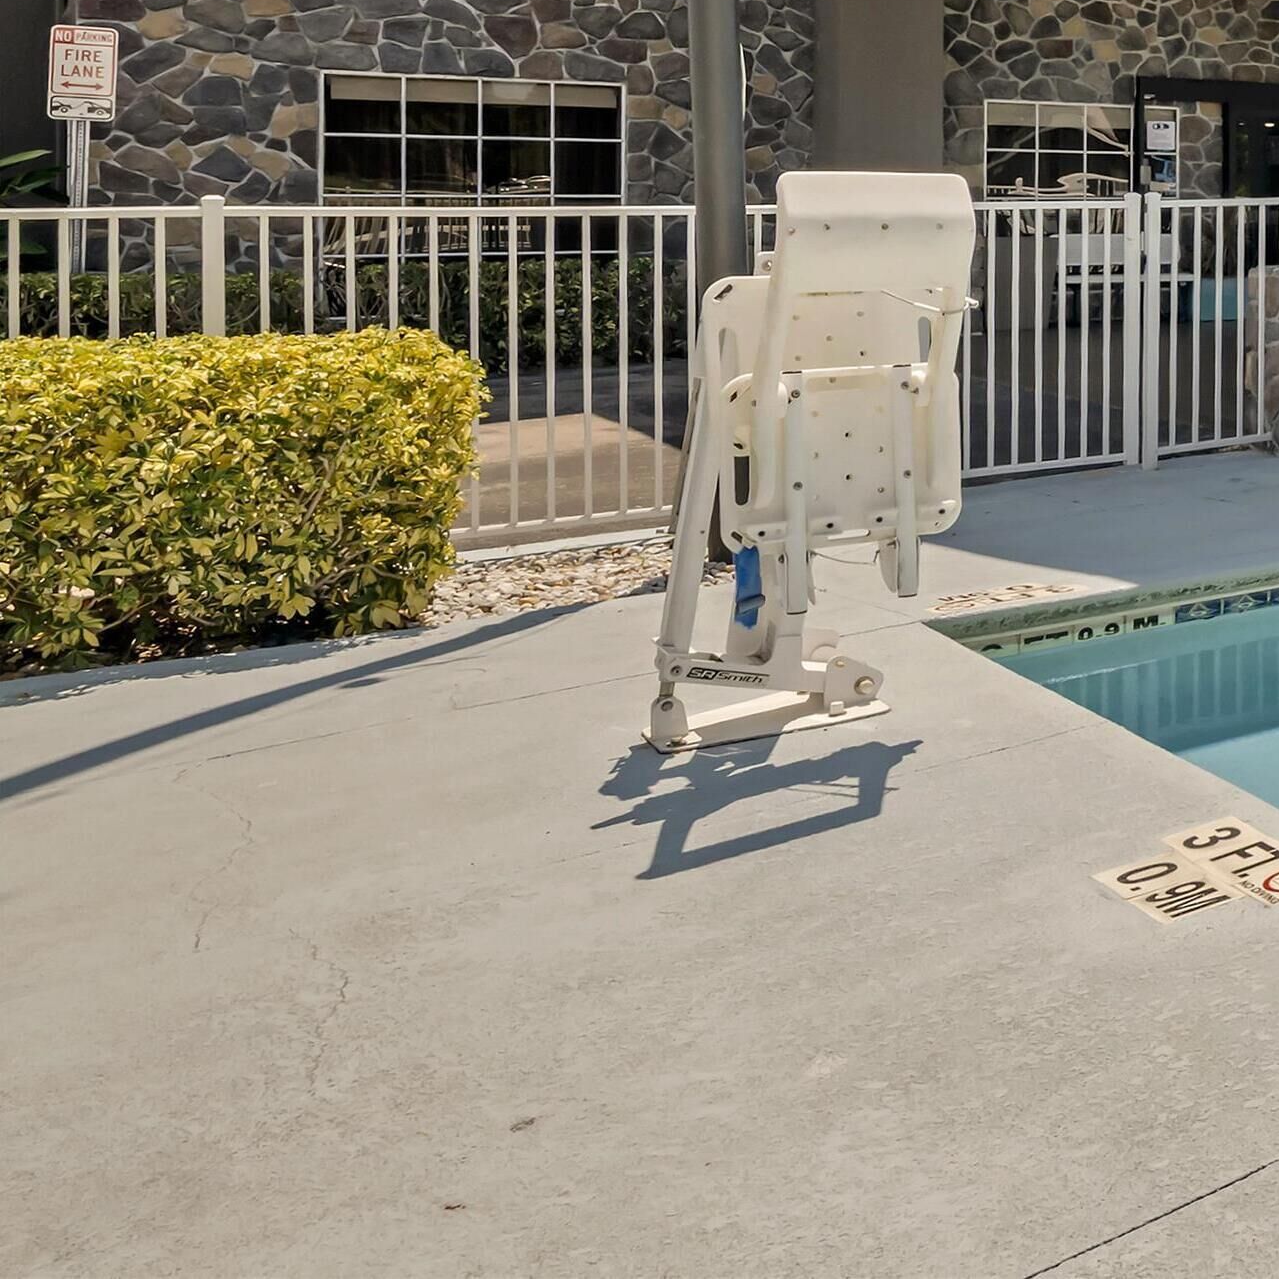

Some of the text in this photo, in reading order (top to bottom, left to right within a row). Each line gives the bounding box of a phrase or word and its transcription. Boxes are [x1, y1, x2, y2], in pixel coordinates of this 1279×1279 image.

[55, 29, 113, 42] NO PARKING
[65, 48, 103, 63] FIRE
[60, 64, 105, 79] LANE
[716, 671, 763, 683] Smith
[1182, 826, 1241, 850] 3
